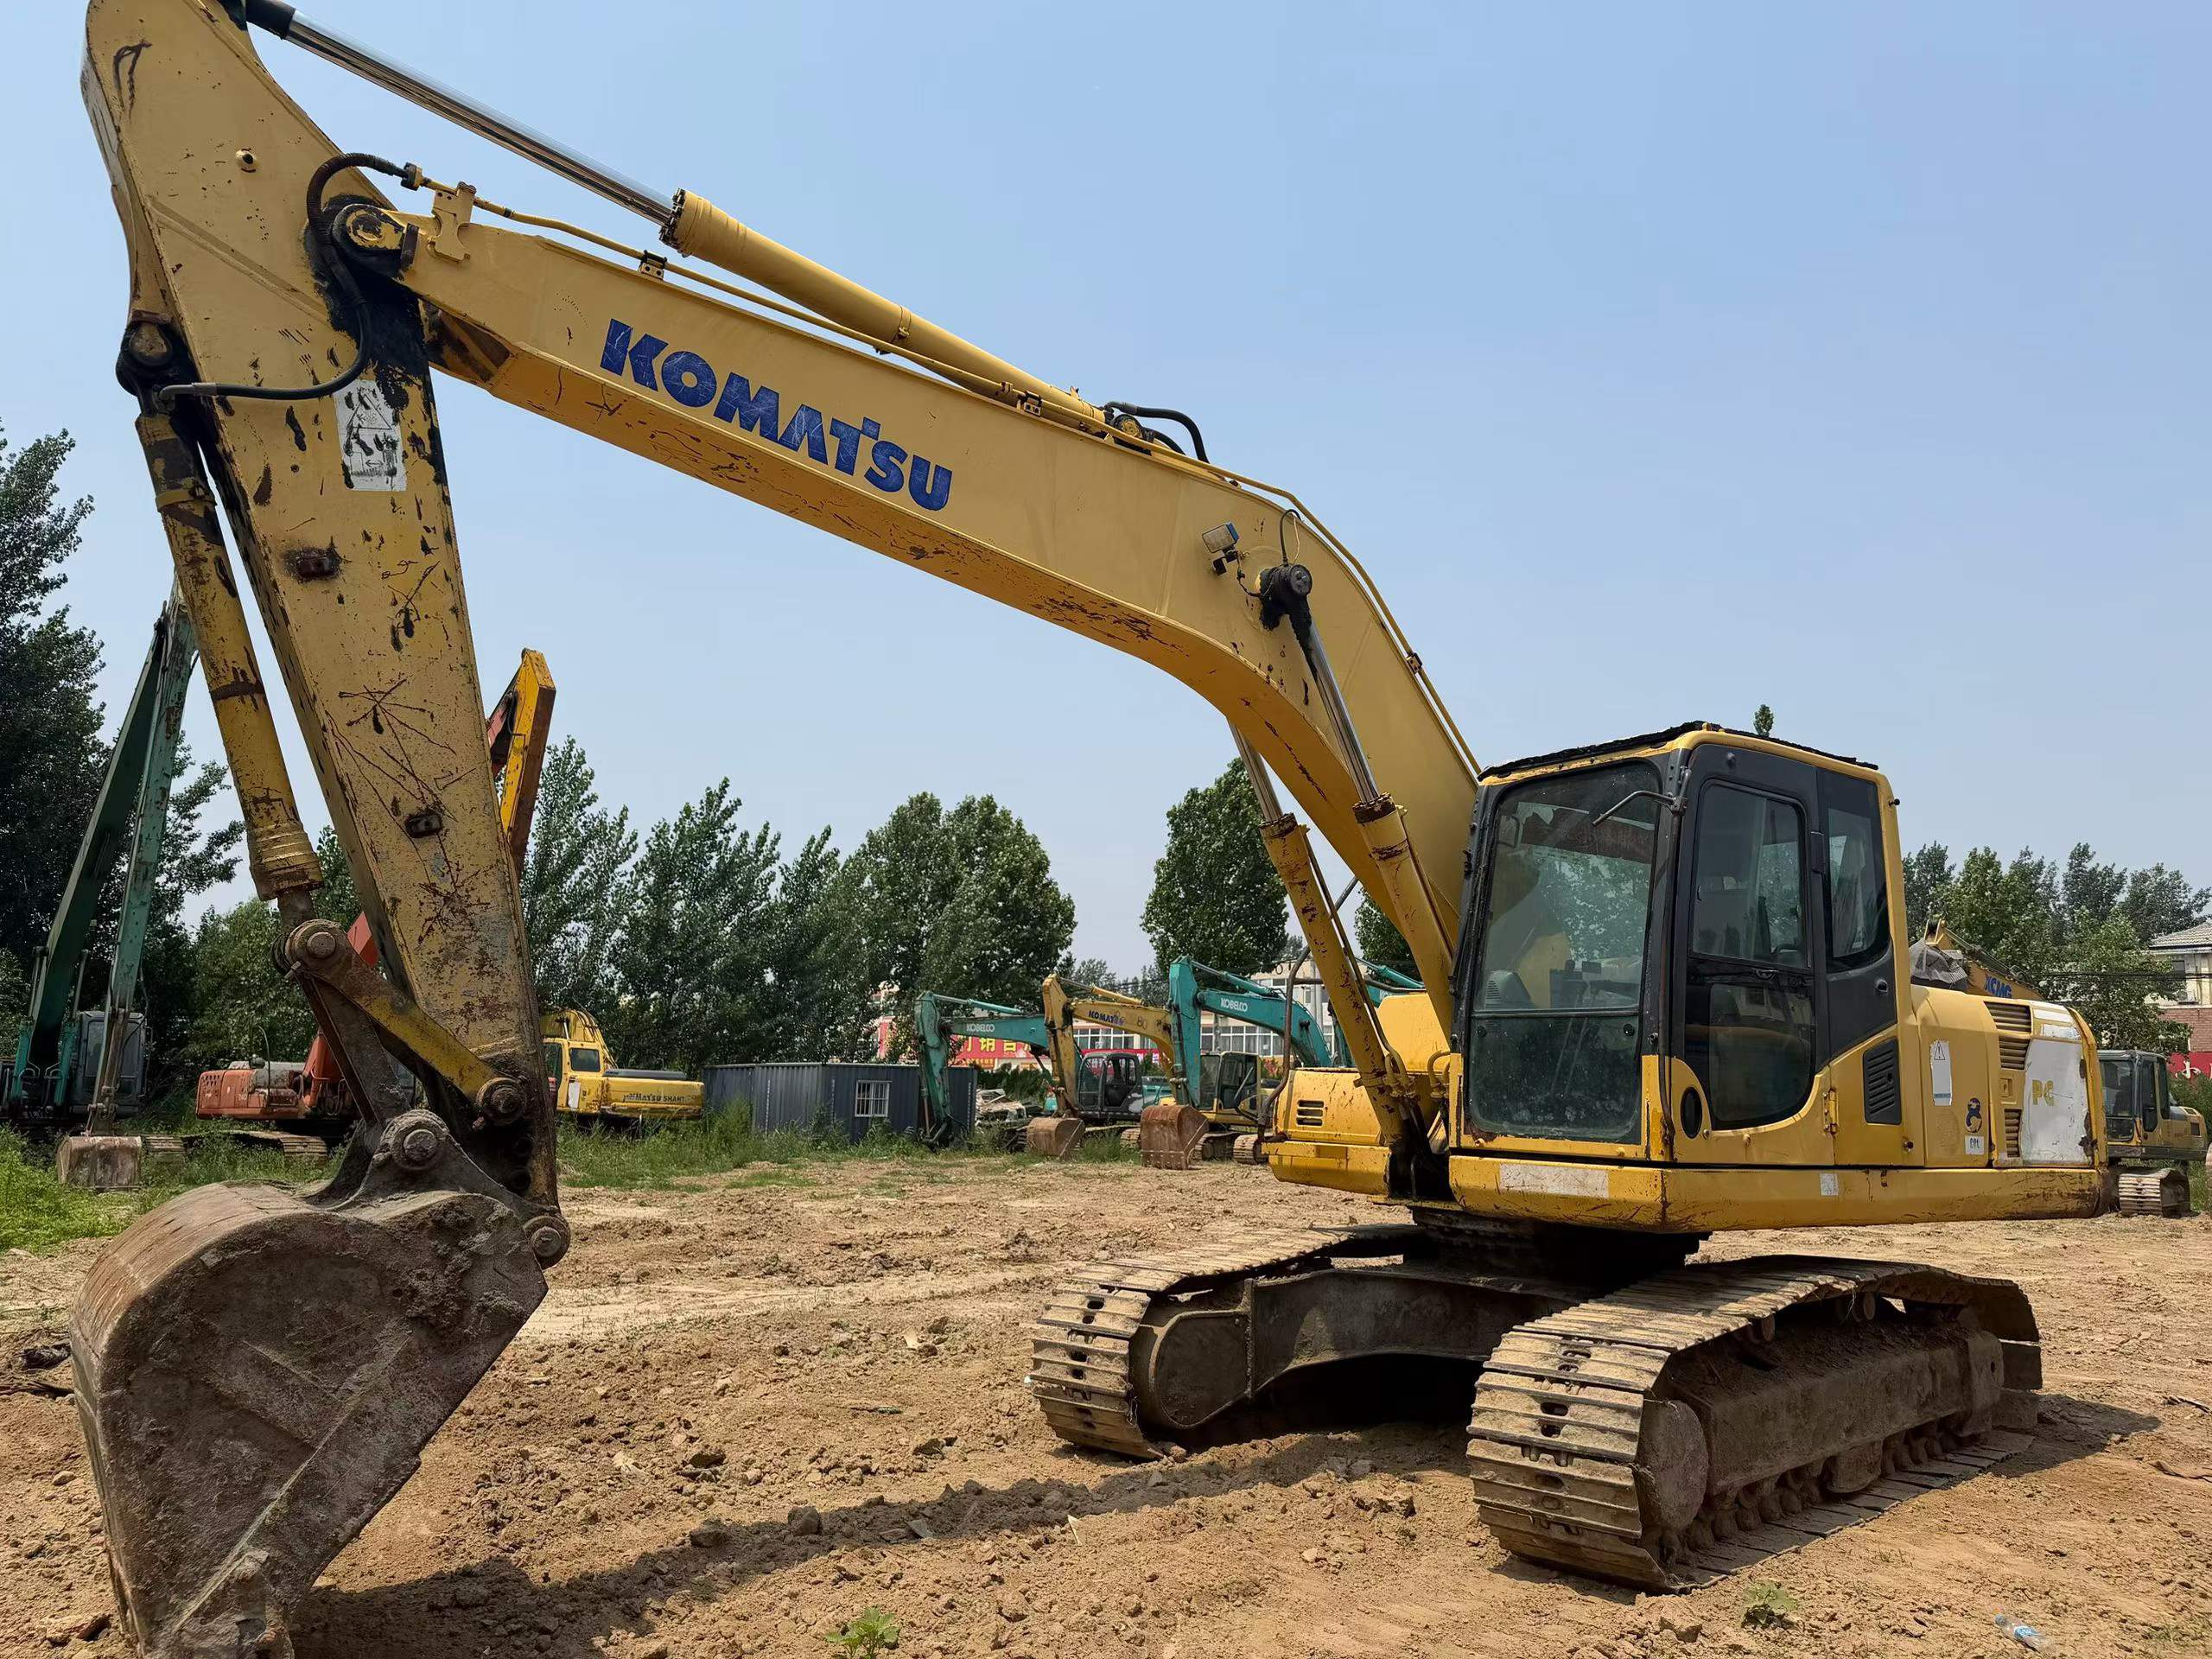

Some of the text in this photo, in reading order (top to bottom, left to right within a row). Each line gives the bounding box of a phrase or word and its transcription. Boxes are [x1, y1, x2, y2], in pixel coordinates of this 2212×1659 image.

[601, 319, 952, 512] KOMATSU
[1220, 997, 1248, 1012] KOBELCO
[966, 1023, 995, 1033] KOBELCO
